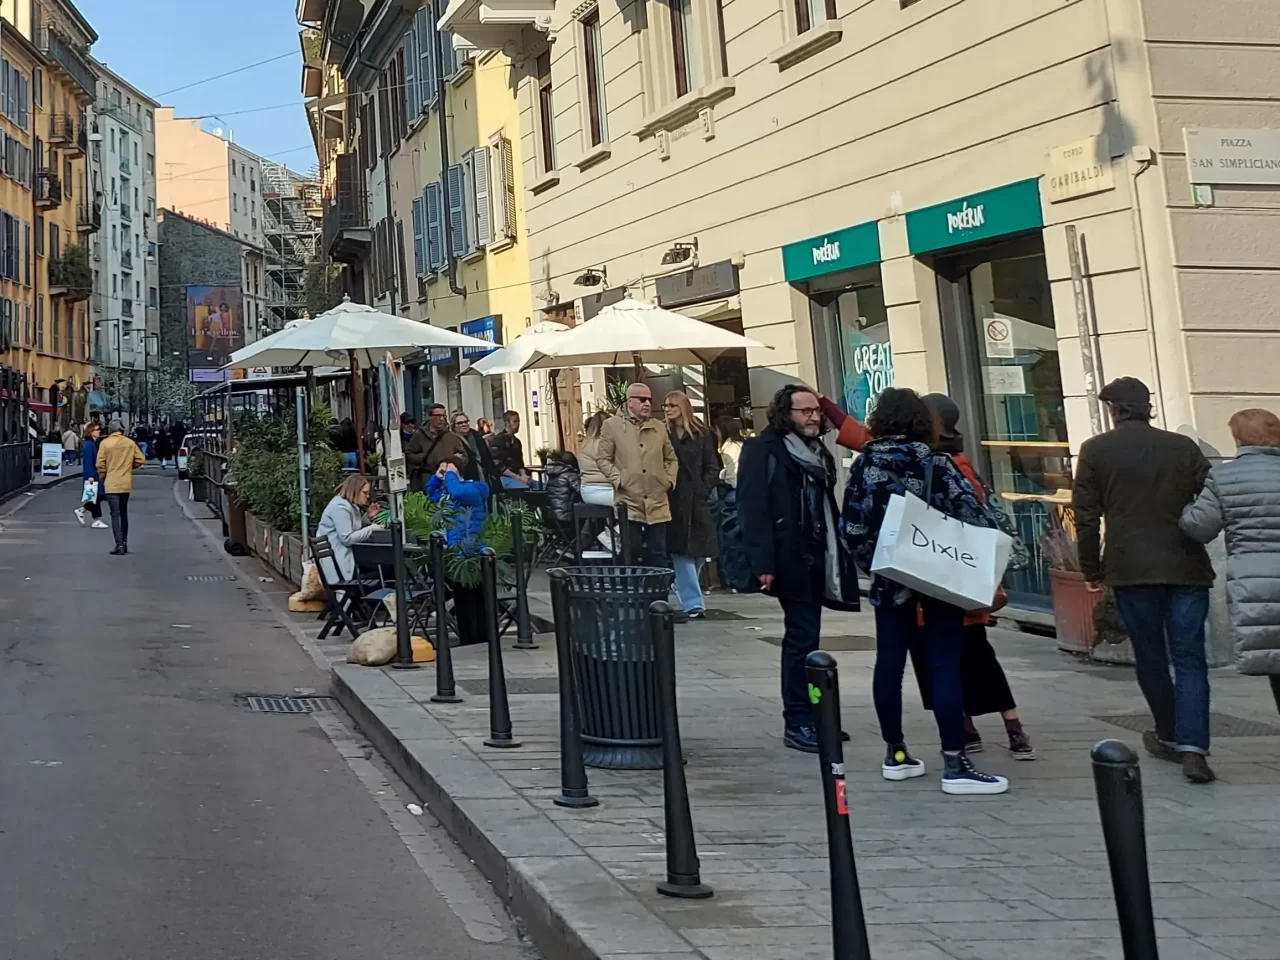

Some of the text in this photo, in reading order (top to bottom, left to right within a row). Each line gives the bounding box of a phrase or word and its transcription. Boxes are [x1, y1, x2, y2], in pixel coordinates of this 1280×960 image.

[1221, 139, 1253, 147] PIAZZA
[1192, 158, 1214, 168] SAN
[1050, 164, 1104, 188] GARIBALDI
